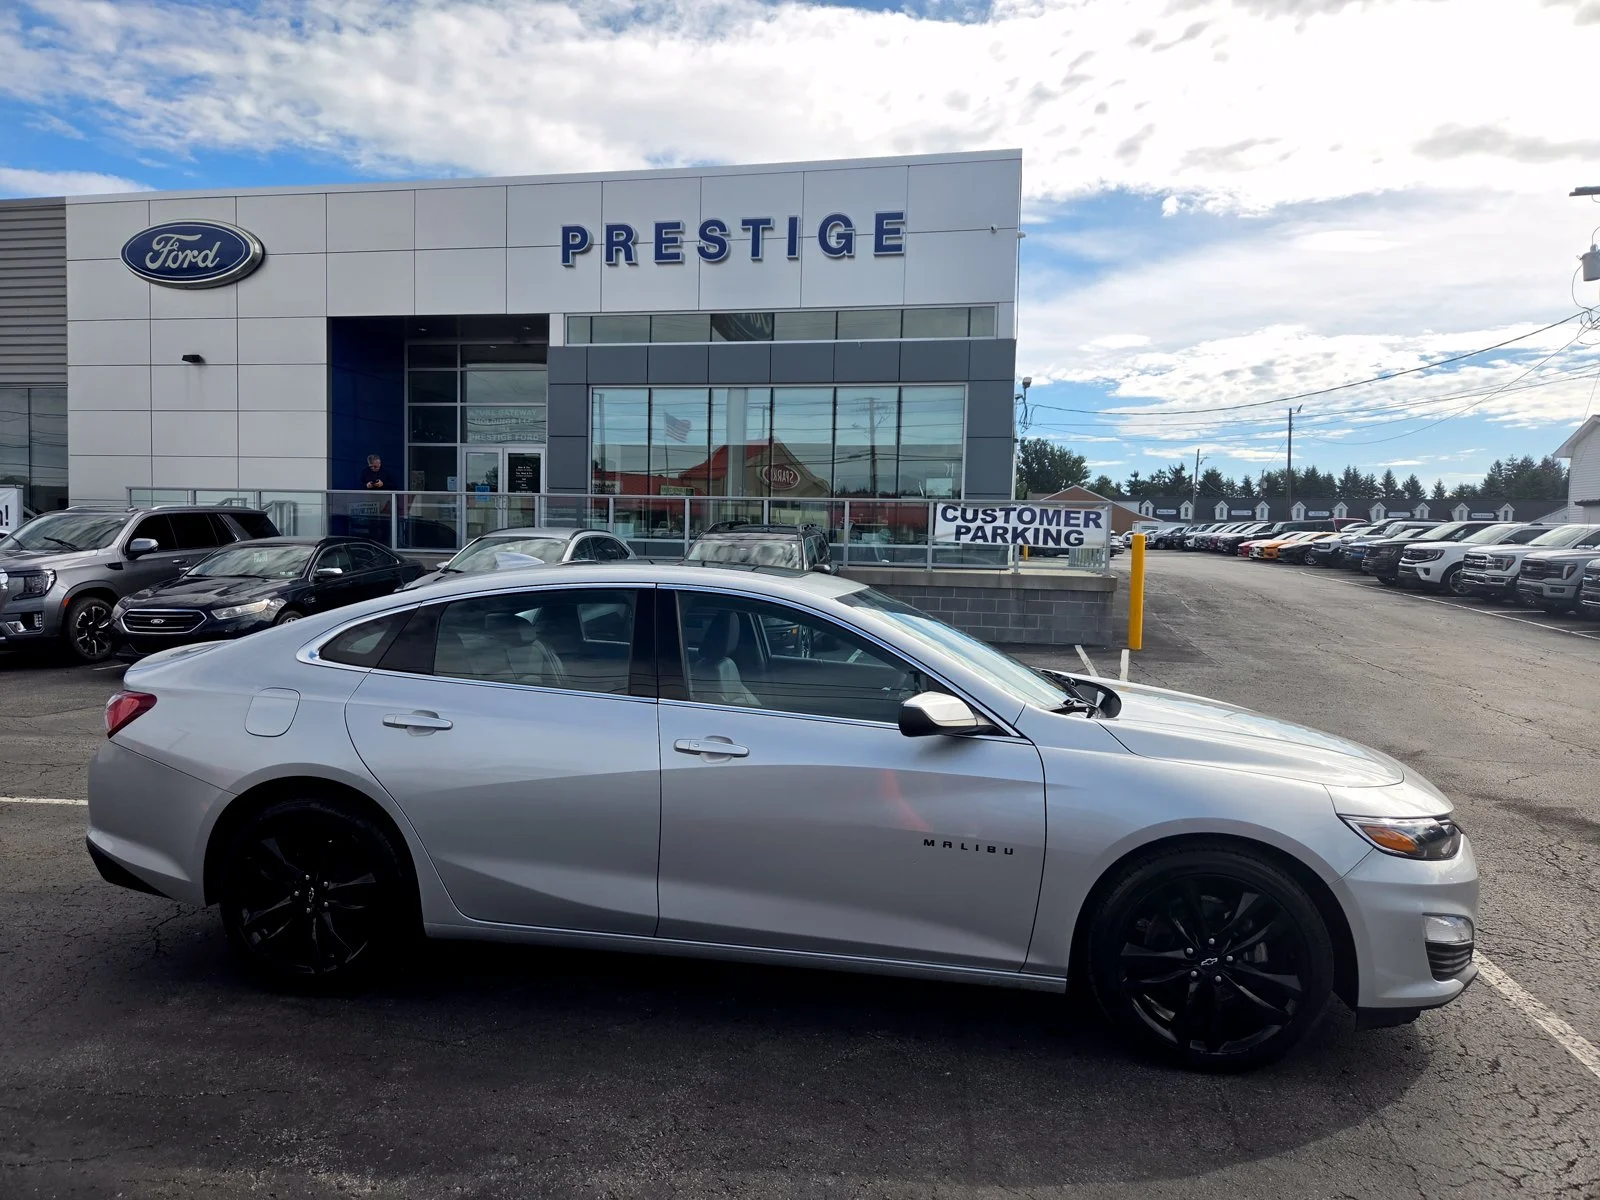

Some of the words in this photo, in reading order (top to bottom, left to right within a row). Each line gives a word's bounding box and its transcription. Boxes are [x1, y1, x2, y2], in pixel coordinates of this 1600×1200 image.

[560, 210, 907, 267] PRESTIGE
[144, 233, 222, 270] Ford
[499, 408, 537, 416] GATEWAY
[515, 433, 539, 441] FORD
[940, 504, 1103, 529] CUSTOMER
[954, 524, 1085, 547] PARKING
[923, 838, 1014, 855] MALIBU
